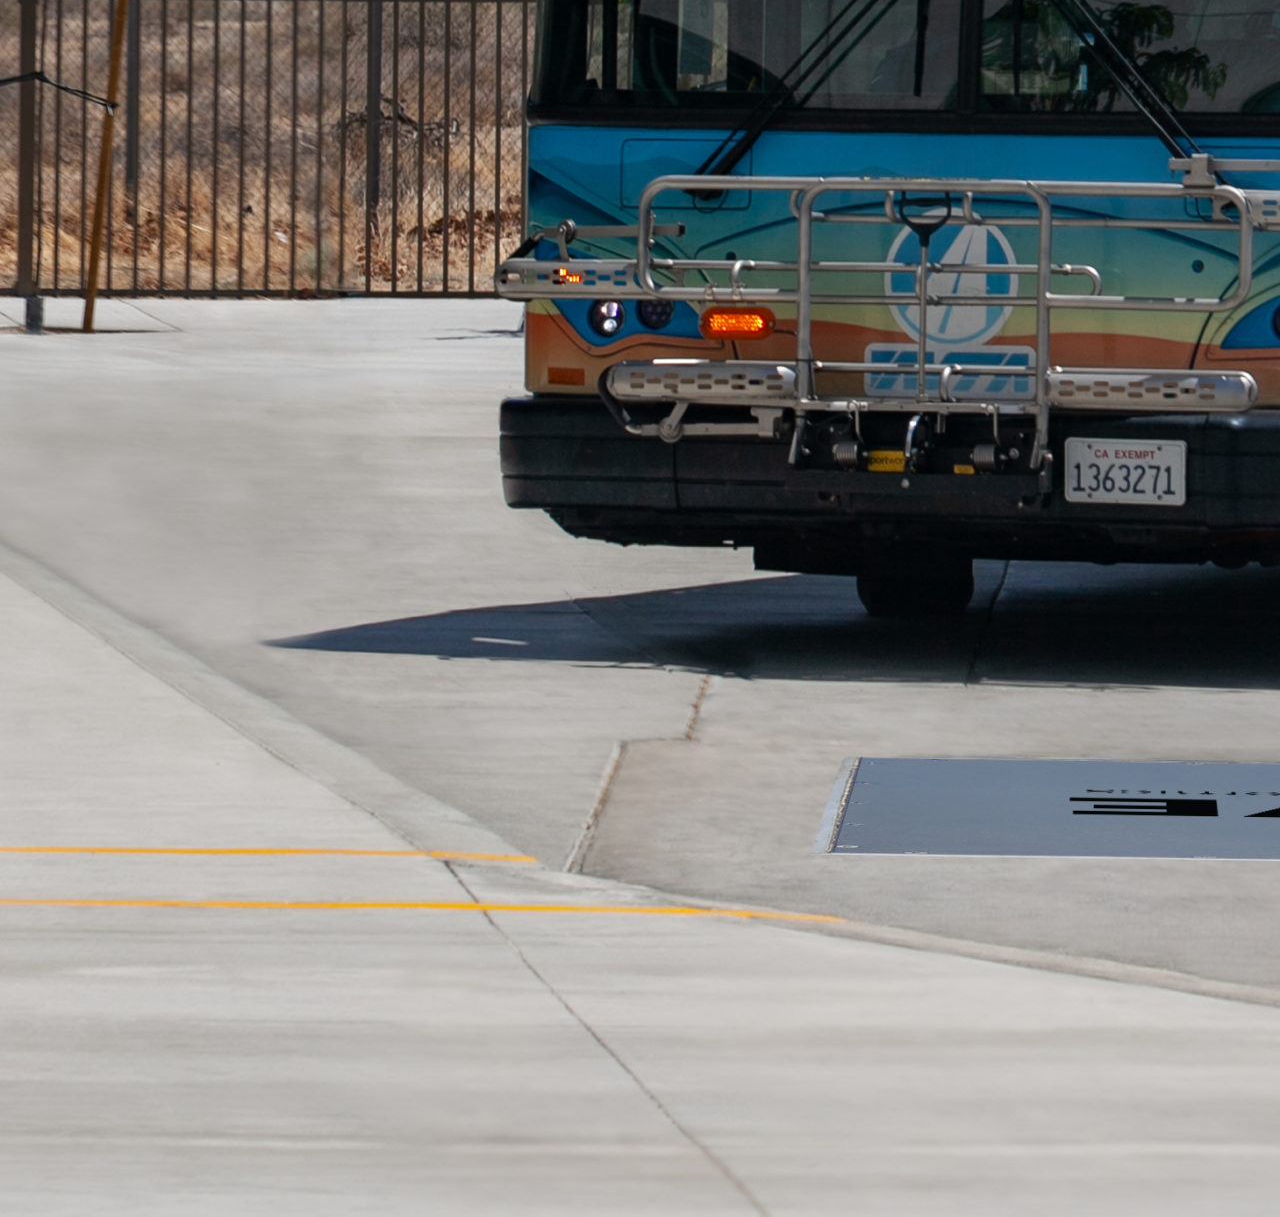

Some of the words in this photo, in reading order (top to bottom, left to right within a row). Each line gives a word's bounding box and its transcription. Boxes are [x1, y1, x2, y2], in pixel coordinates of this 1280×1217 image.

[1094, 449, 1109, 459] CA
[1114, 449, 1157, 460] EXEMPT
[1072, 462, 1176, 495] 1363271
